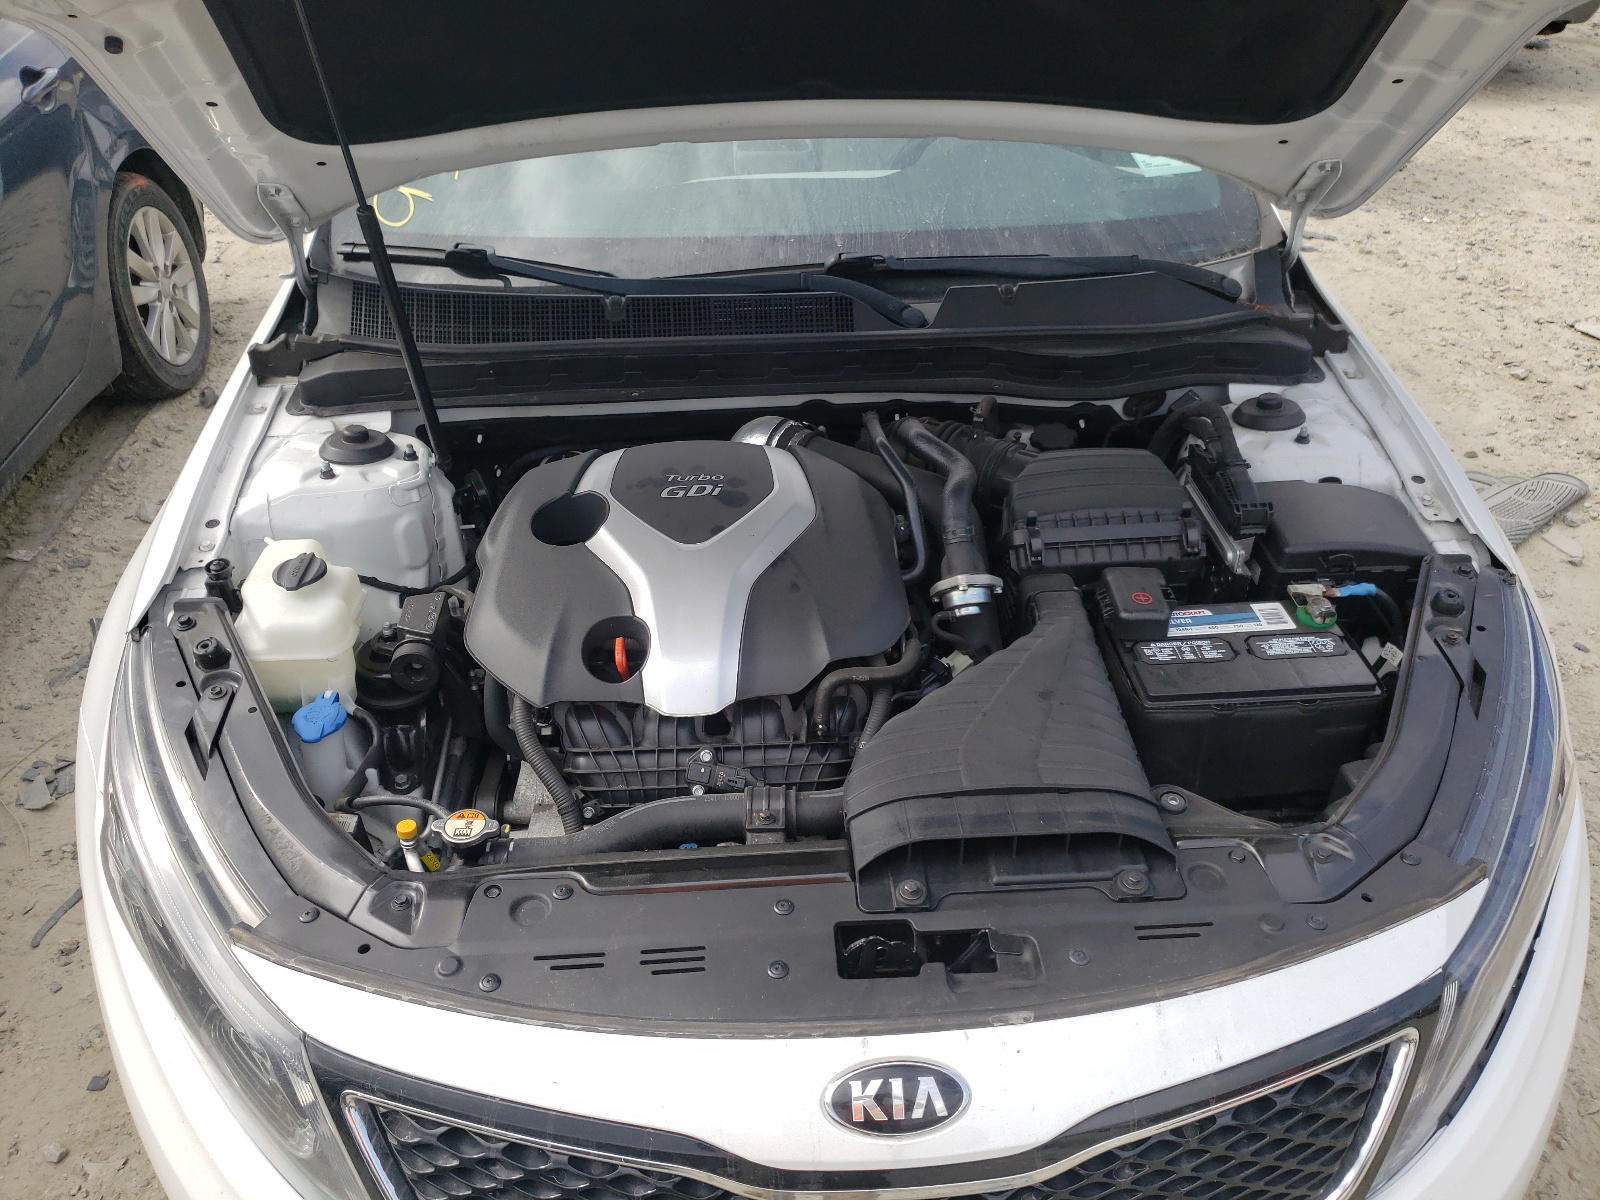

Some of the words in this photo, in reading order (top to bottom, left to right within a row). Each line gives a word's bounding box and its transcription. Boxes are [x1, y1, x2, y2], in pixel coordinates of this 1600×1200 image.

[665, 474, 725, 482] Turbo
[660, 484, 724, 498] GDi
[849, 1076, 949, 1122] KIA
